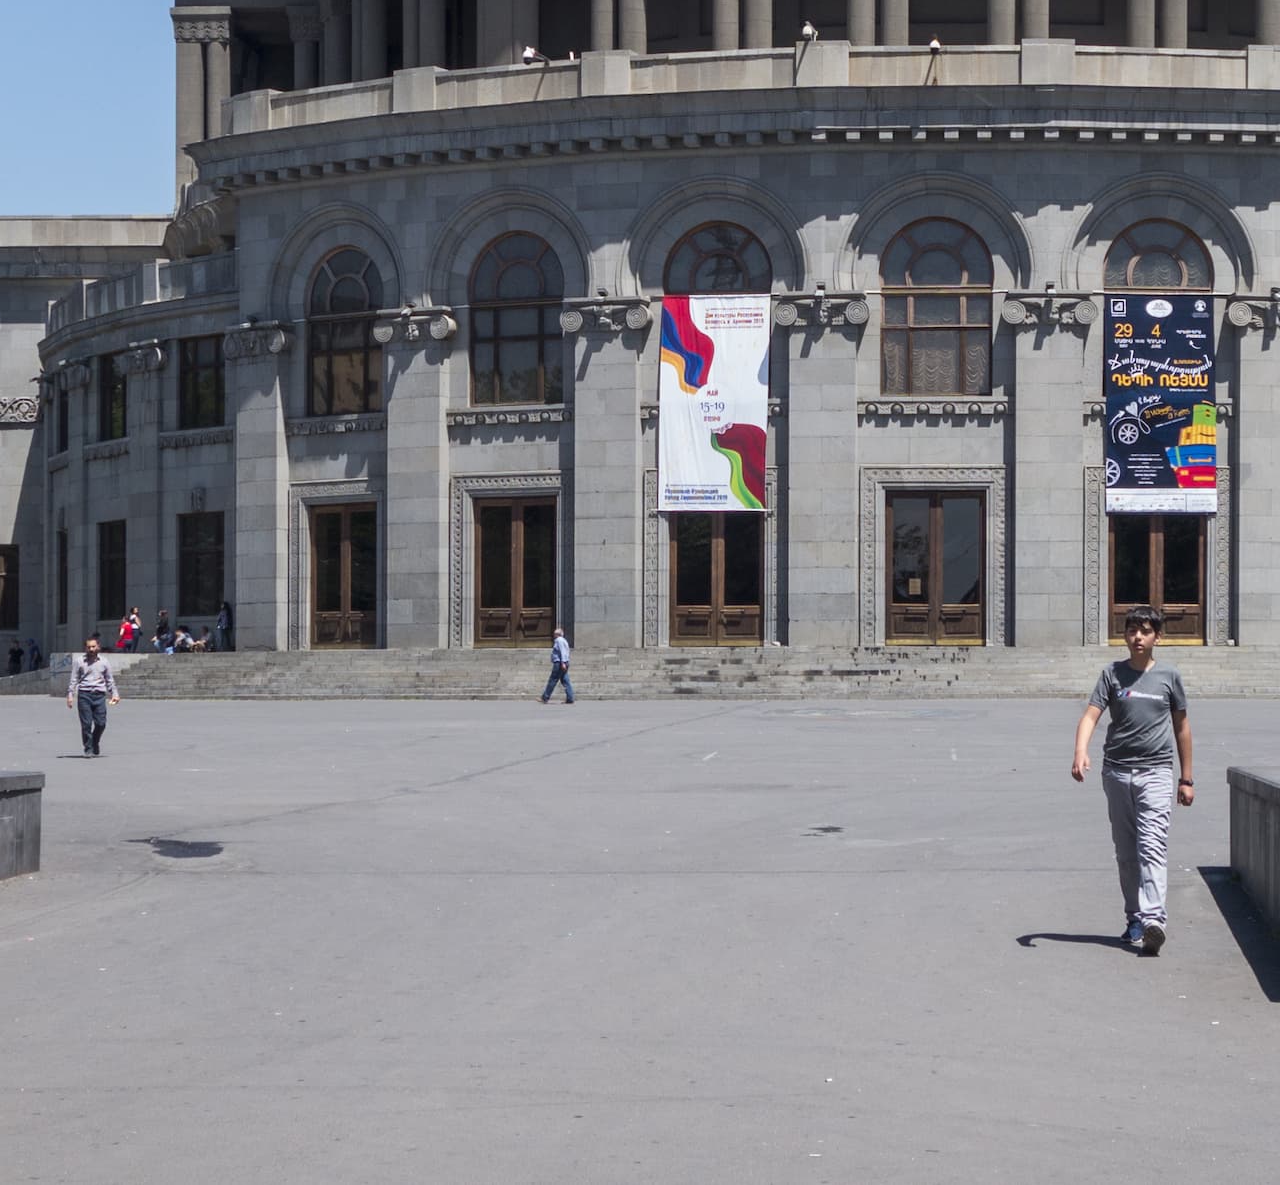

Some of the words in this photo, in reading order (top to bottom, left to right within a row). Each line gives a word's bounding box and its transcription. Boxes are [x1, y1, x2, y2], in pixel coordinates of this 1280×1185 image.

[1114, 323, 1133, 338] 29
[1151, 323, 1161, 338] 4
[700, 401, 725, 414] 15-19
